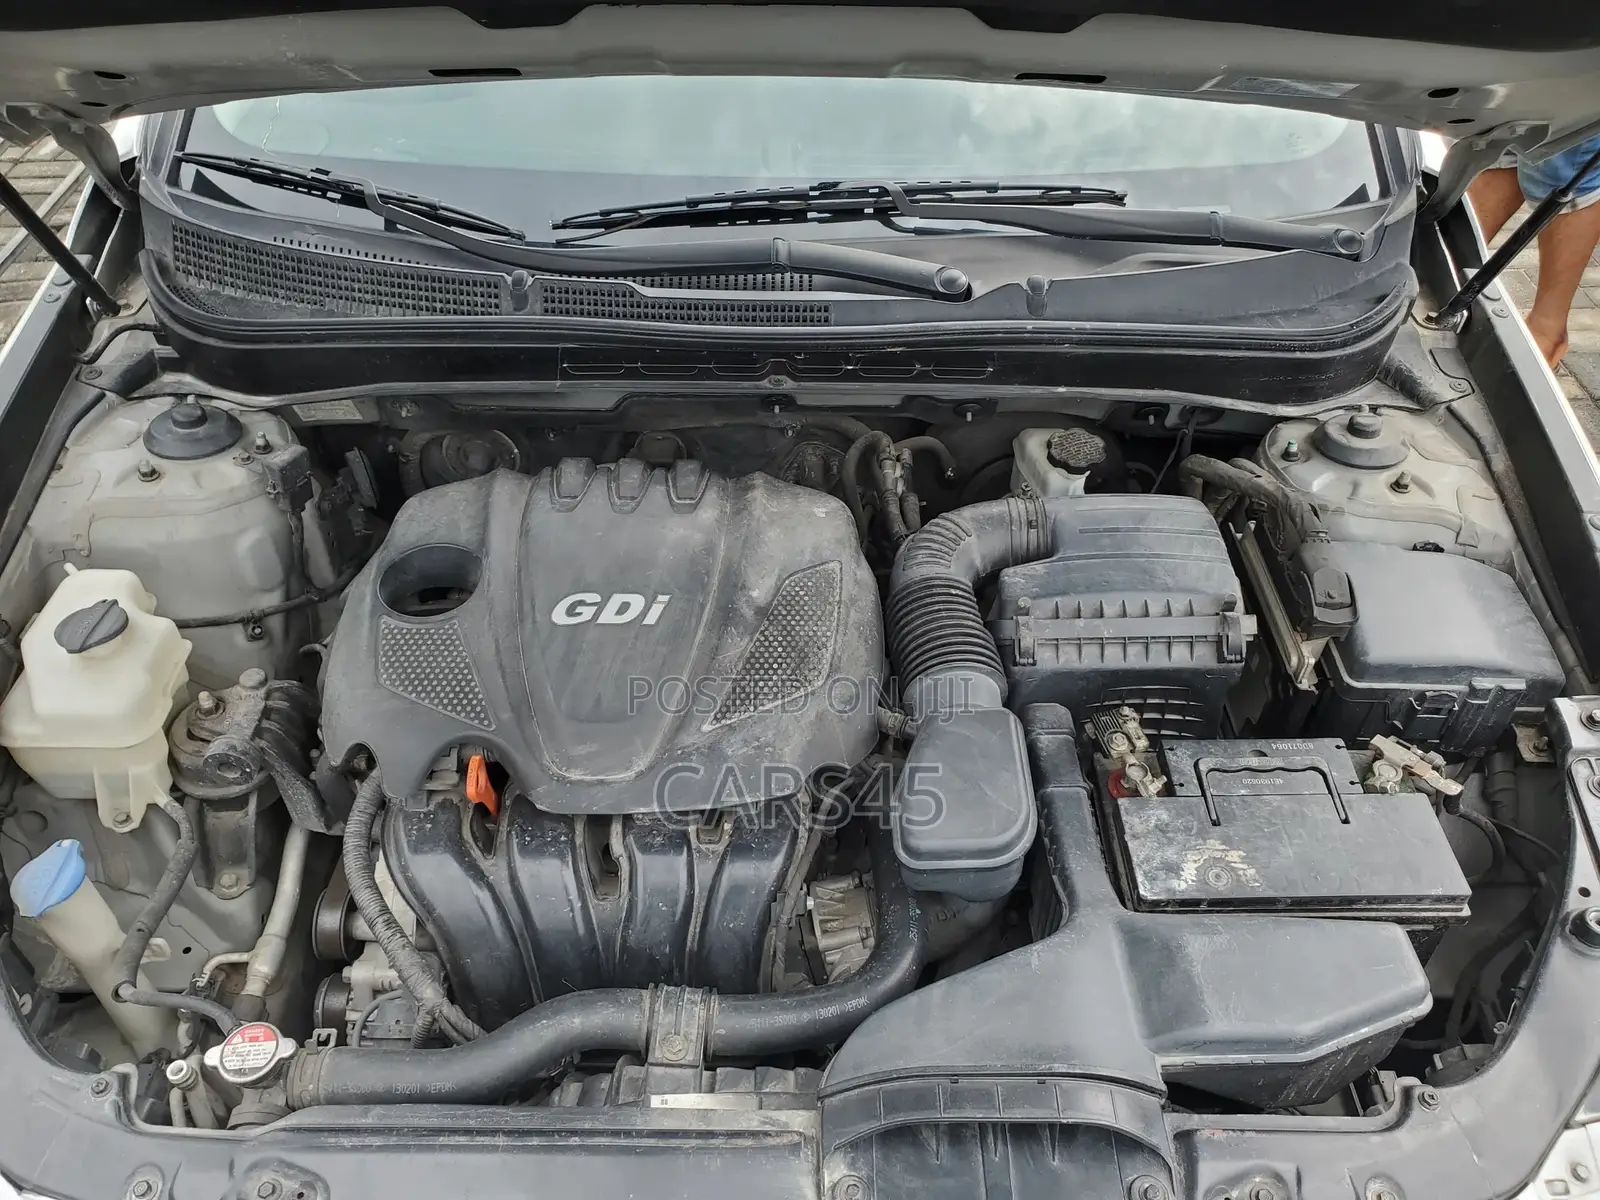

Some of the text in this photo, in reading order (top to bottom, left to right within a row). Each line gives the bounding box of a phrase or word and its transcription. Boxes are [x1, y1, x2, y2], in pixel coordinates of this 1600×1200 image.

[551, 591, 673, 626] GDi
[815, 1004, 840, 1020] 130201
[392, 1082, 420, 1094] 130201
